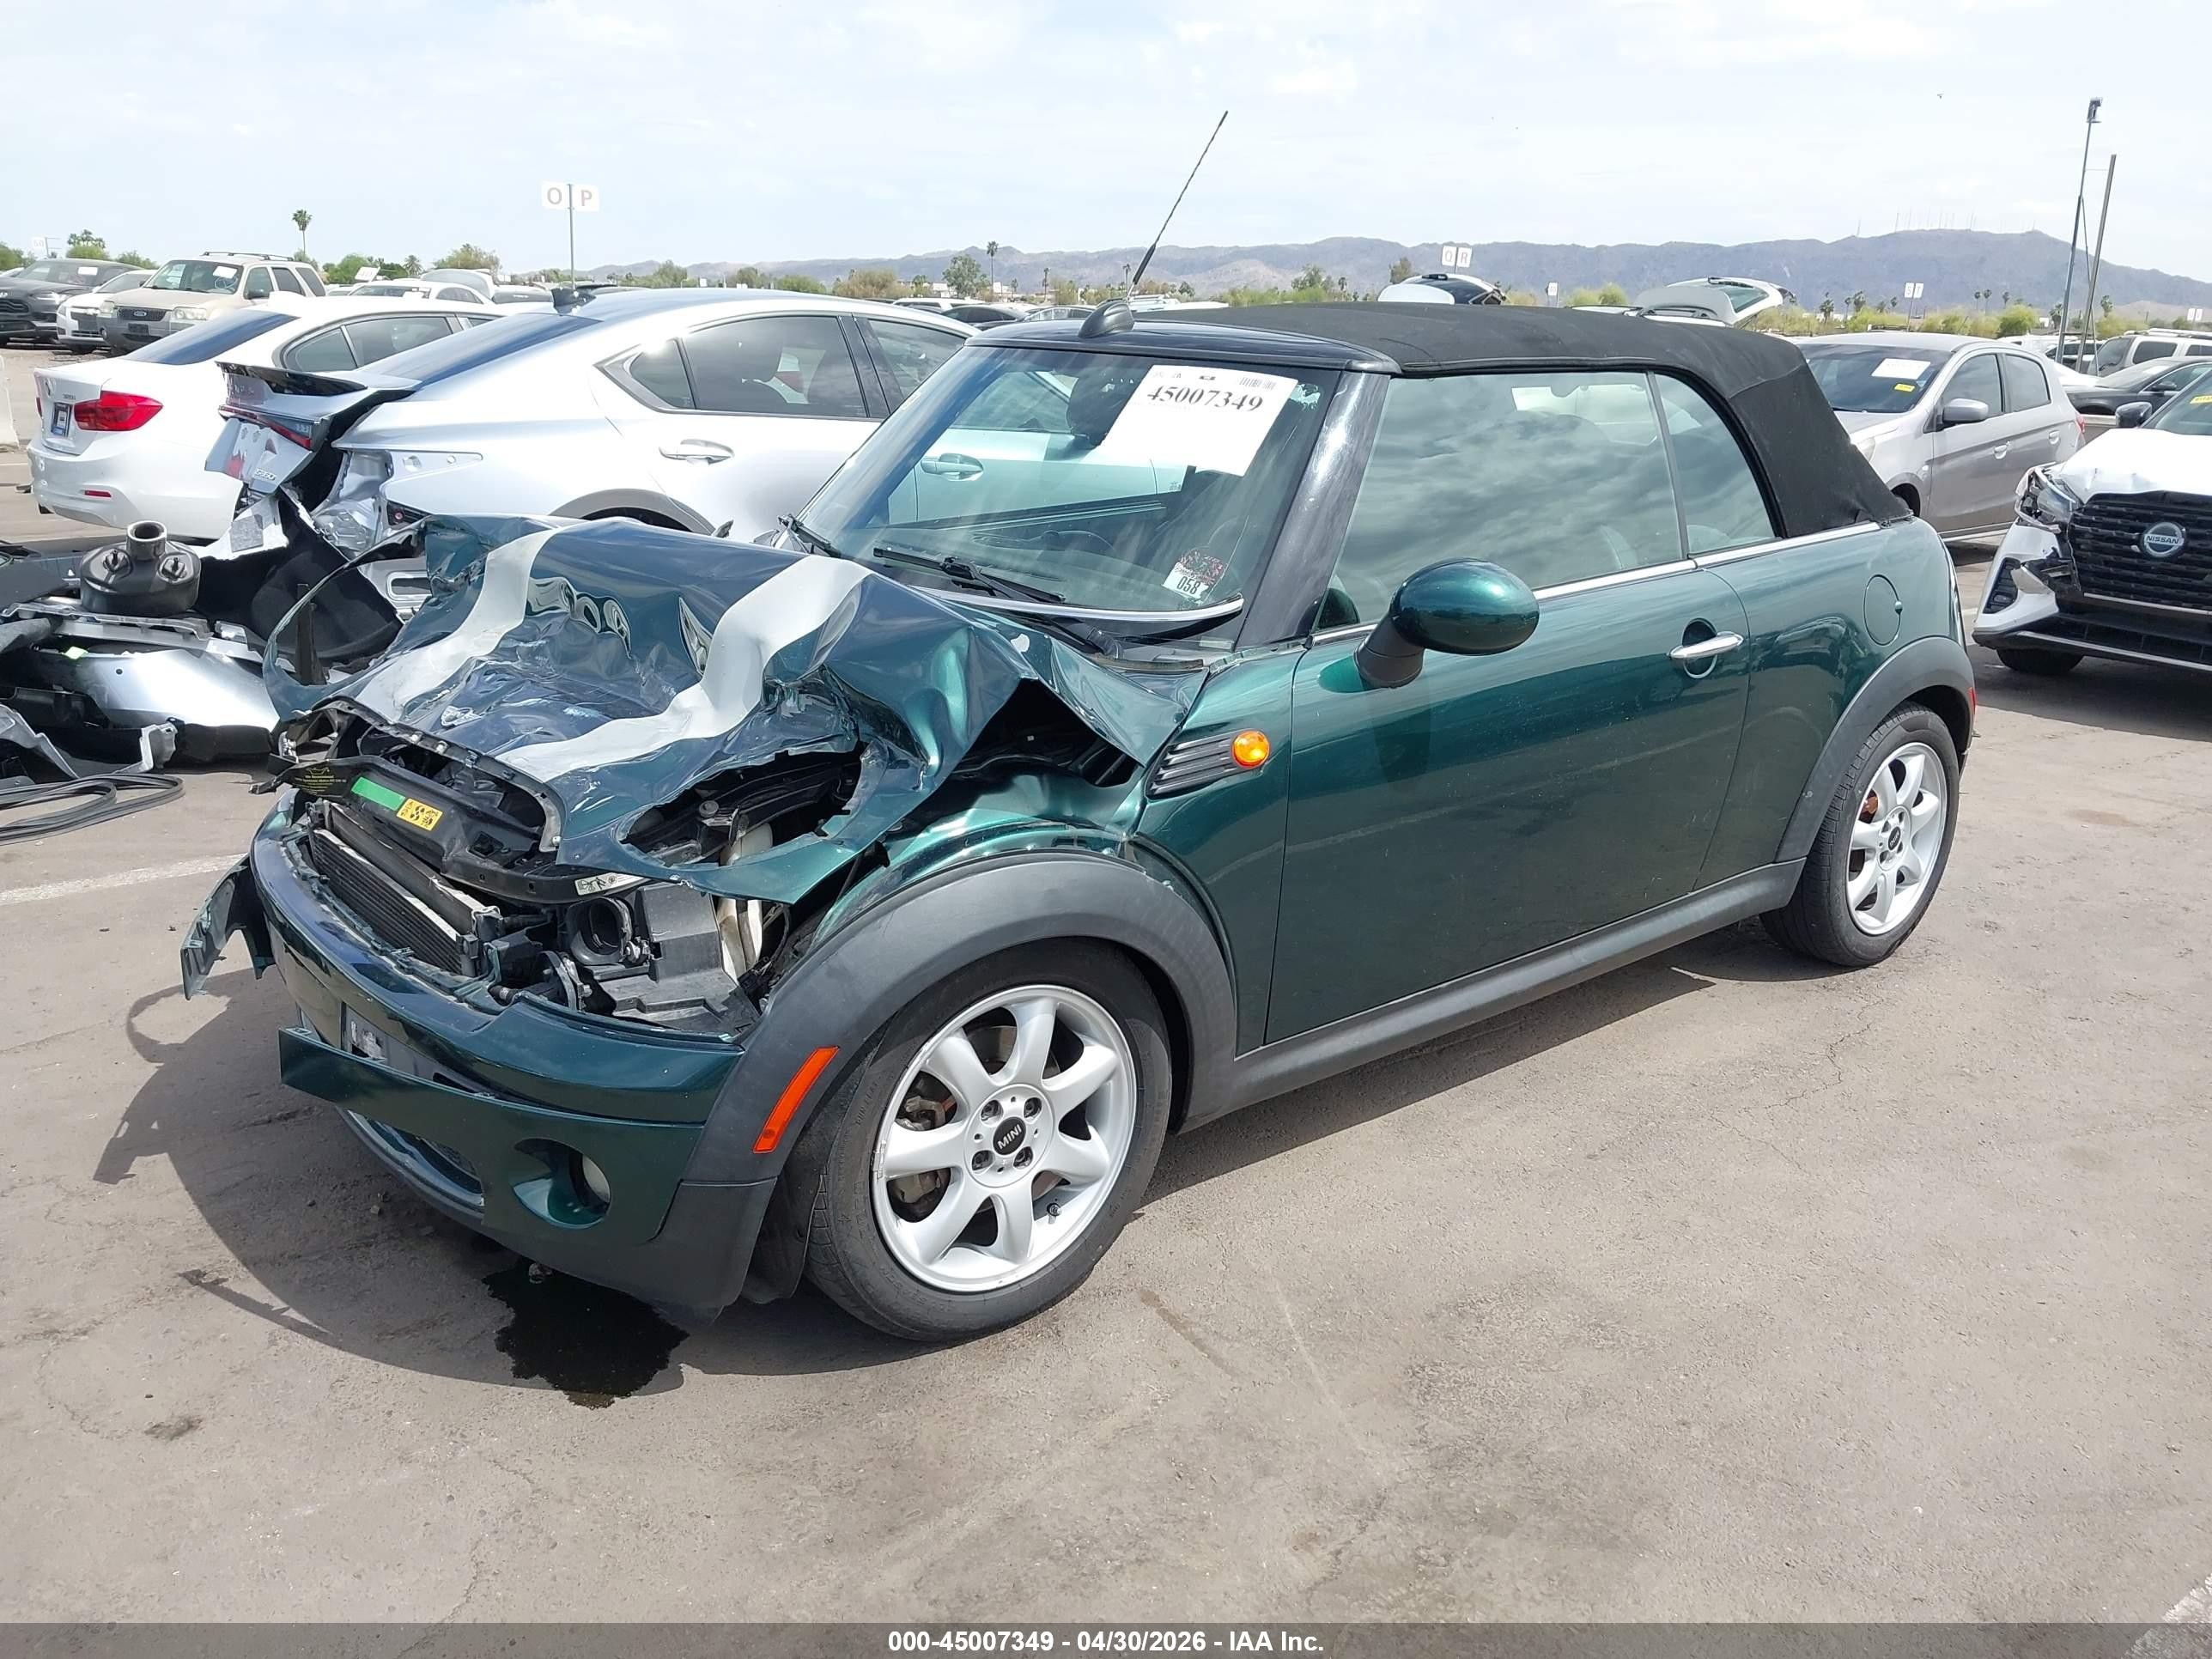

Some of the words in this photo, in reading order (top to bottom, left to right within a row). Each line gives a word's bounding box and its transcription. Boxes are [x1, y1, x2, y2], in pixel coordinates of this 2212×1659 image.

[547, 187, 562, 205] O
[580, 189, 592, 206] P
[1461, 252, 1468, 264] R
[1146, 386, 1263, 411] 45007349
[2147, 535, 2179, 544] NISSAN
[1176, 576, 1201, 595] 058
[997, 1123, 1022, 1150] MINI
